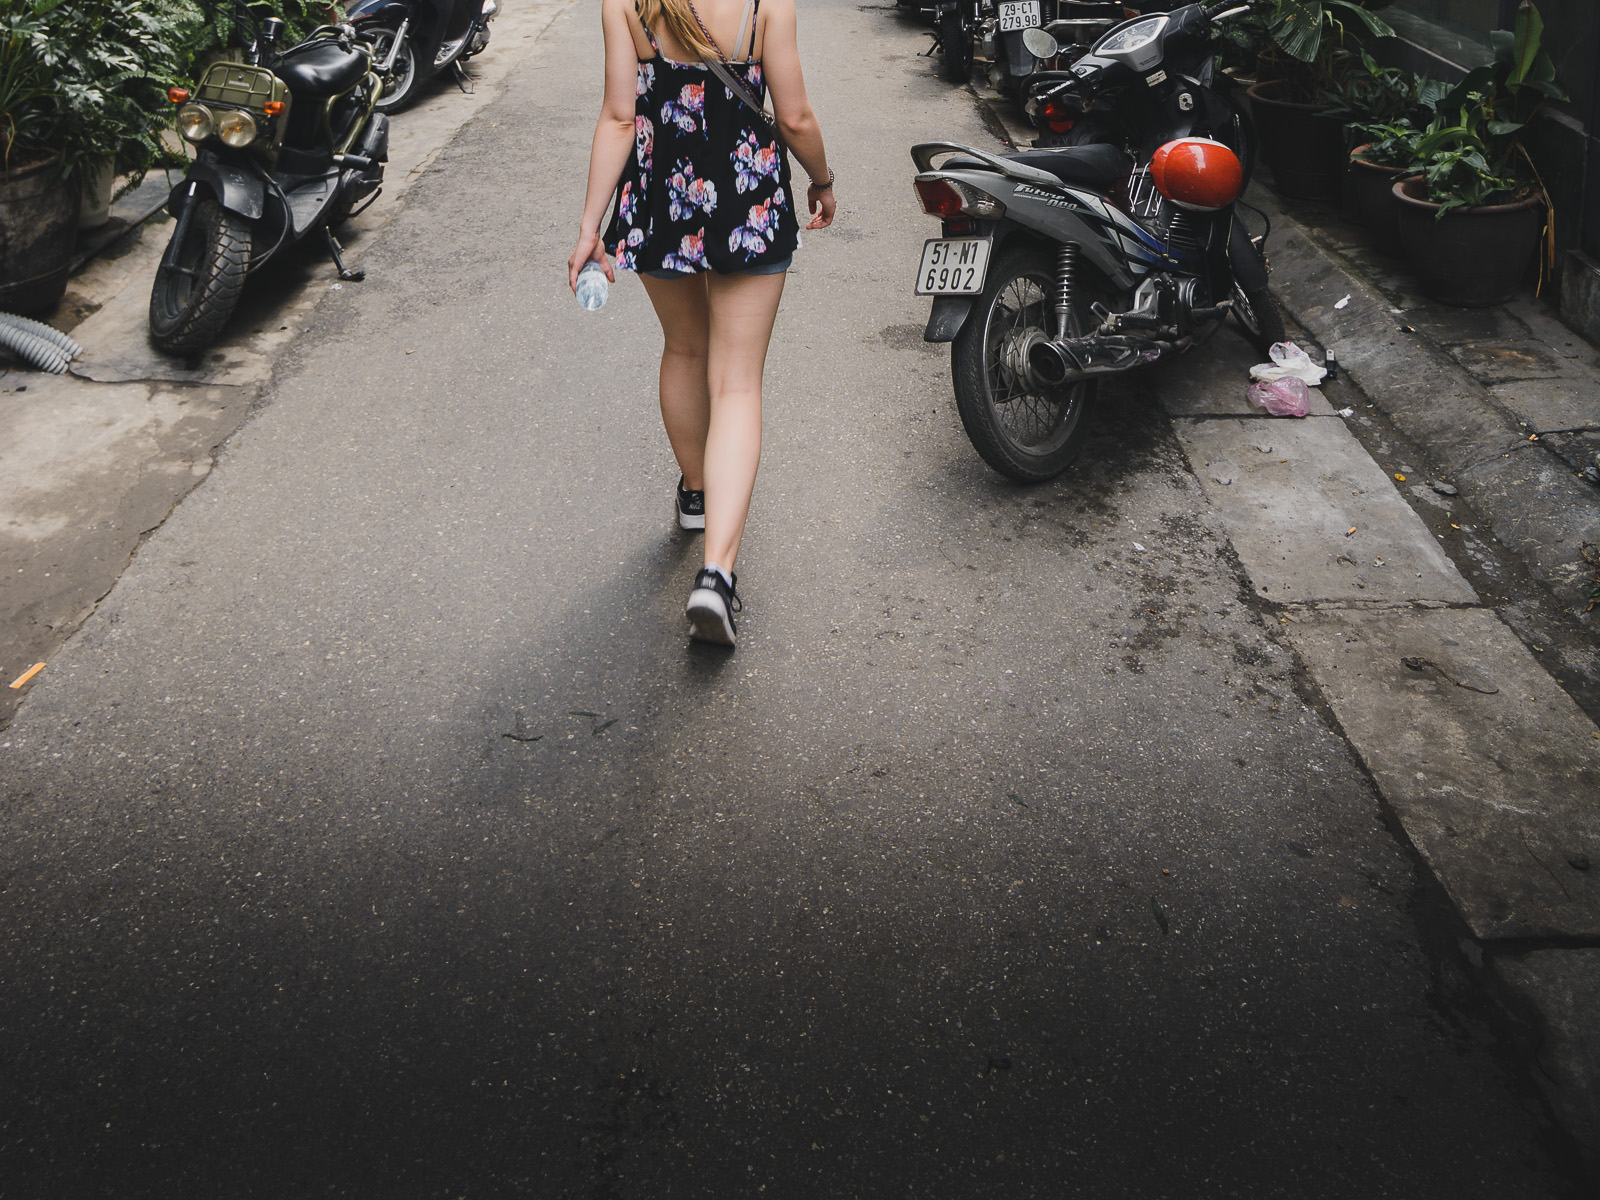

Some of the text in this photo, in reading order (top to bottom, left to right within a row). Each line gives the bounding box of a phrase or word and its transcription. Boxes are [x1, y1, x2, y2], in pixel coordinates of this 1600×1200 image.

[1004, 1, 1033, 17] 29-C1
[1002, 15, 1038, 30] 279.98
[1013, 182, 1065, 200] Future
[931, 242, 979, 265] 51-N1
[925, 267, 975, 291] 6902
